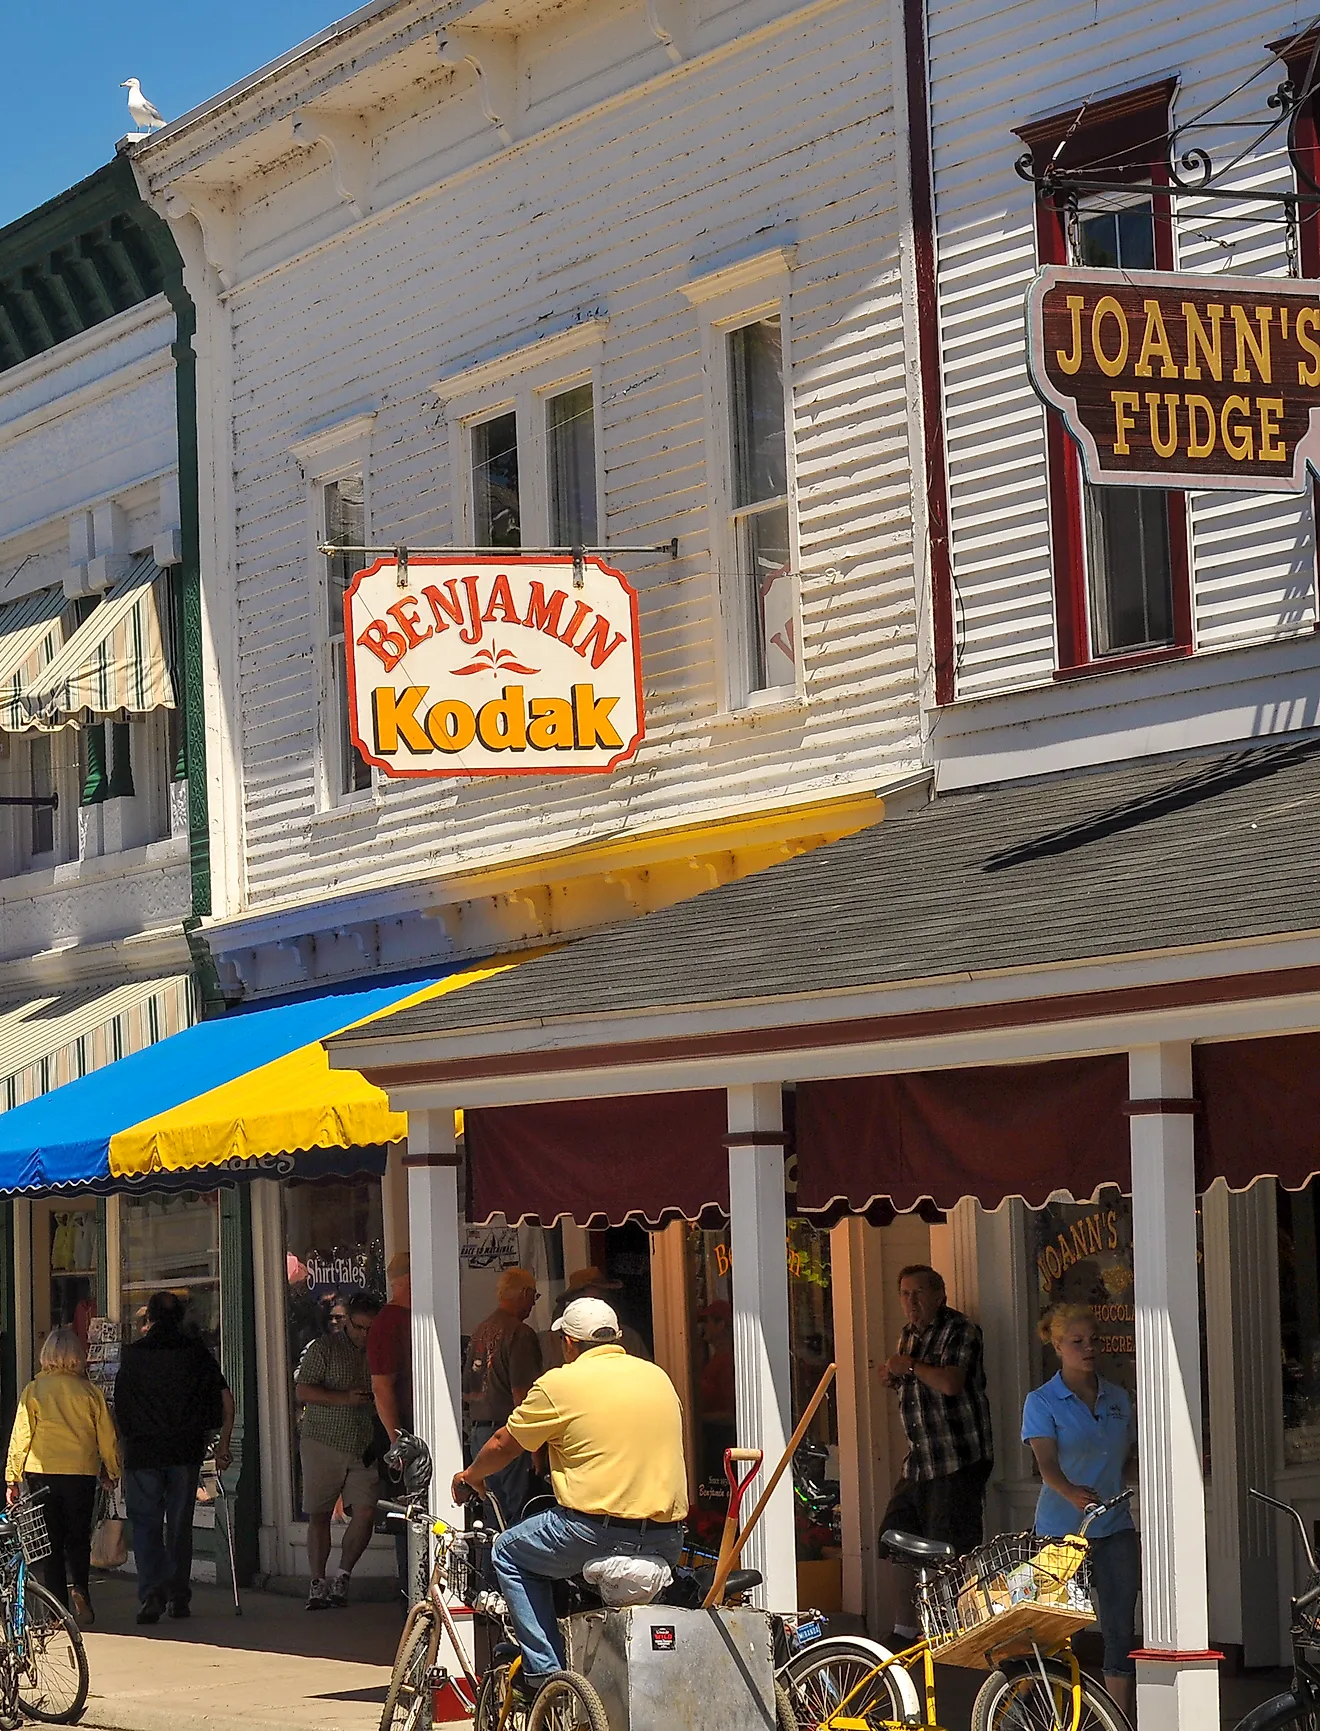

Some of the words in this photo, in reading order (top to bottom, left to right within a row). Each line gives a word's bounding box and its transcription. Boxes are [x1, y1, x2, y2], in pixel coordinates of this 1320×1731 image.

[1056, 295, 1320, 388] JOANN'S
[1111, 391, 1287, 462] FUDGE
[356, 574, 628, 674] BENJAMIN
[371, 684, 625, 756] Kodak
[306, 1258, 336, 1291] Shirt
[334, 1258, 366, 1289] Tales
[1036, 1210, 1119, 1293] JOANN'S
